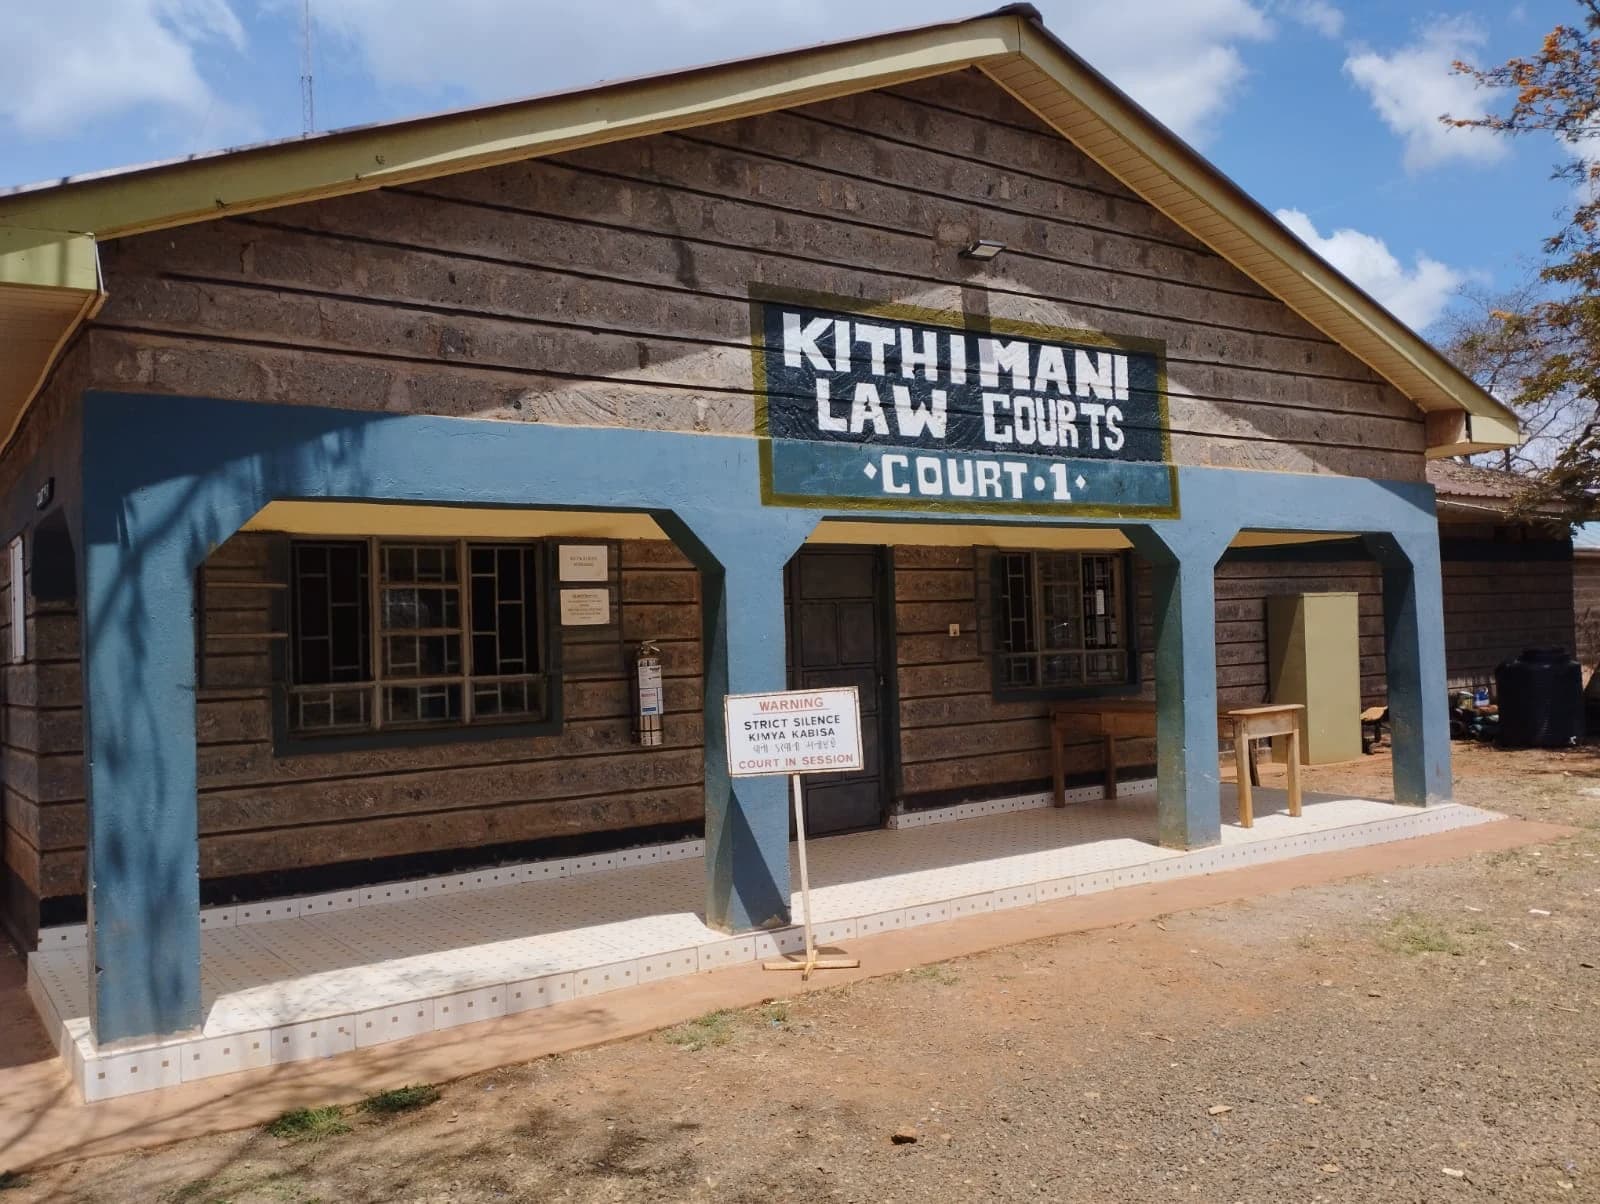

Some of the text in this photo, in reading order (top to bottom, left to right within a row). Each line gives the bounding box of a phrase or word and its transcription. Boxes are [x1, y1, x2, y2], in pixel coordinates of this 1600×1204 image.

[816, 378, 1124, 451] LAW COURTS
[881, 454, 1071, 500] COURT 1
[759, 697, 824, 712] WARNING
[744, 714, 840, 730] STRICT SILENCE
[748, 727, 836, 741] KIMYA KABISA
[738, 753, 854, 770] COURT IN SESSION
